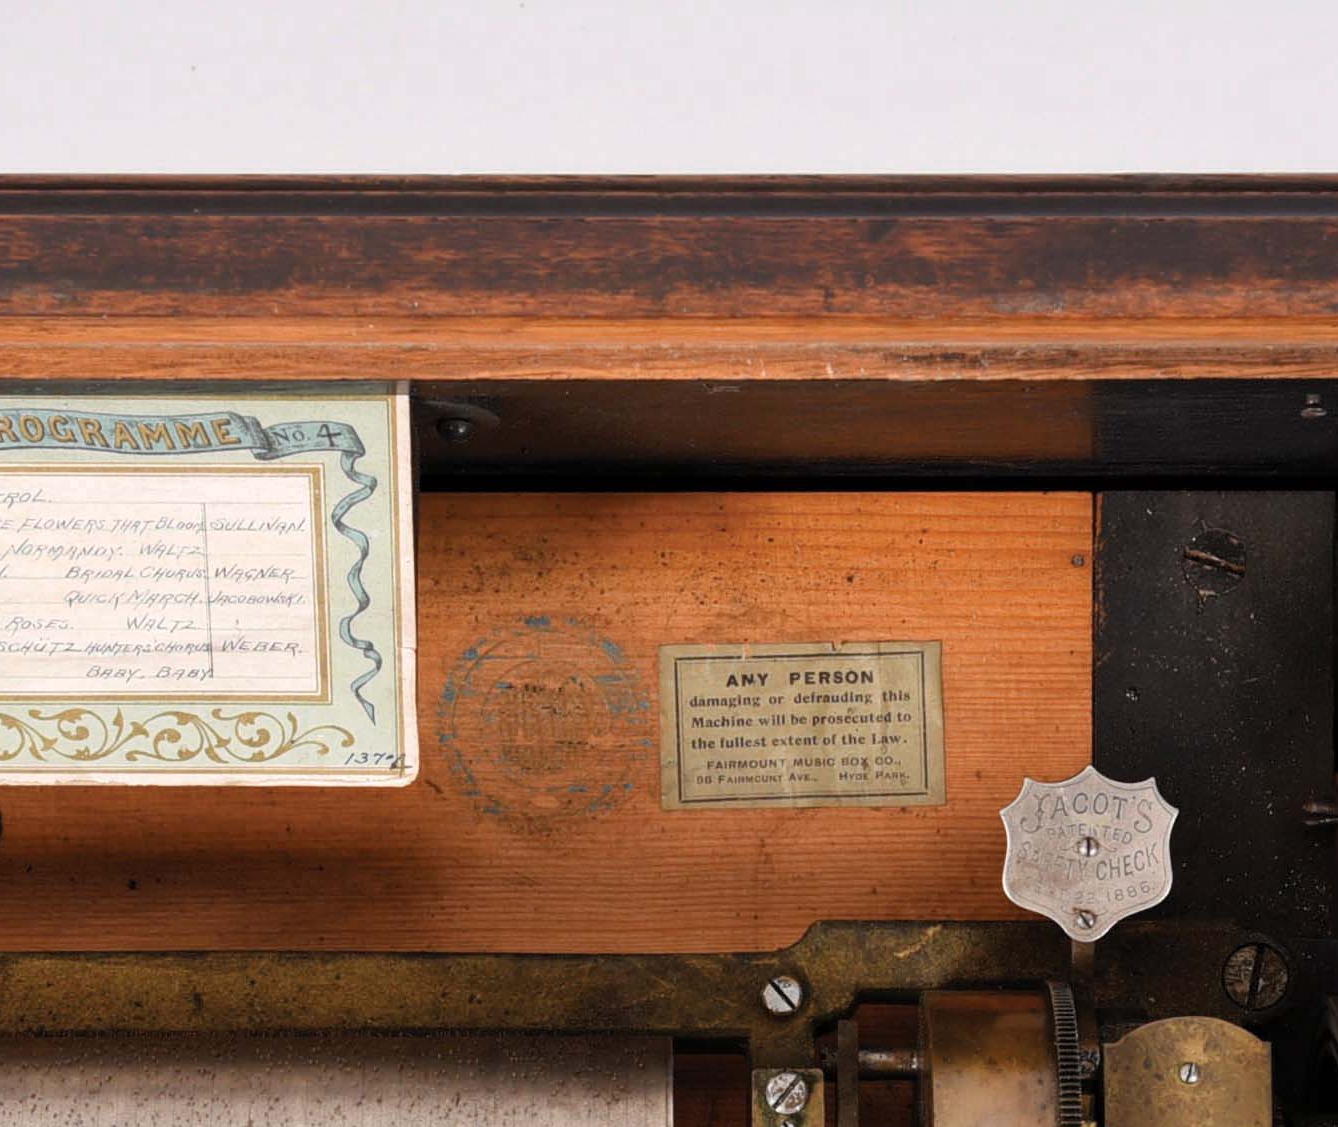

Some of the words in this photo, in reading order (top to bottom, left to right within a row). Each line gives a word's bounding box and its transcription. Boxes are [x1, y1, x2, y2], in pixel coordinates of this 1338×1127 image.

[270, 427, 311, 445] No.
[316, 423, 344, 448] 4
[17, 517, 105, 537] FLOWERS
[111, 518, 155, 534] THAT
[139, 540, 205, 562] WALTZ
[65, 566, 134, 583] BRIDAL
[64, 589, 126, 609] QUICK
[726, 672, 769, 688] ANY
[789, 670, 875, 686] PERSON
[689, 695, 761, 709] damaging
[768, 696, 785, 705] or
[793, 691, 873, 705] defrauding
[882, 690, 911, 702] this
[691, 715, 754, 729] Machine
[758, 714, 786, 727] will
[791, 713, 808, 726] be
[812, 711, 892, 727] prosecuted
[897, 711, 912, 723] to
[691, 737, 716, 750] the
[720, 735, 767, 749] fullest
[772, 735, 818, 747] extent
[822, 734, 838, 746] of
[841, 733, 866, 746] the
[871, 733, 908, 746] Law.
[706, 758, 786, 770] FAIRMOUNT
[793, 757, 836, 768] MUSIC
[841, 756, 869, 768] BOX
[1019, 792, 1154, 835] JACOT'S
[1096, 842, 1160, 881] CHECK
